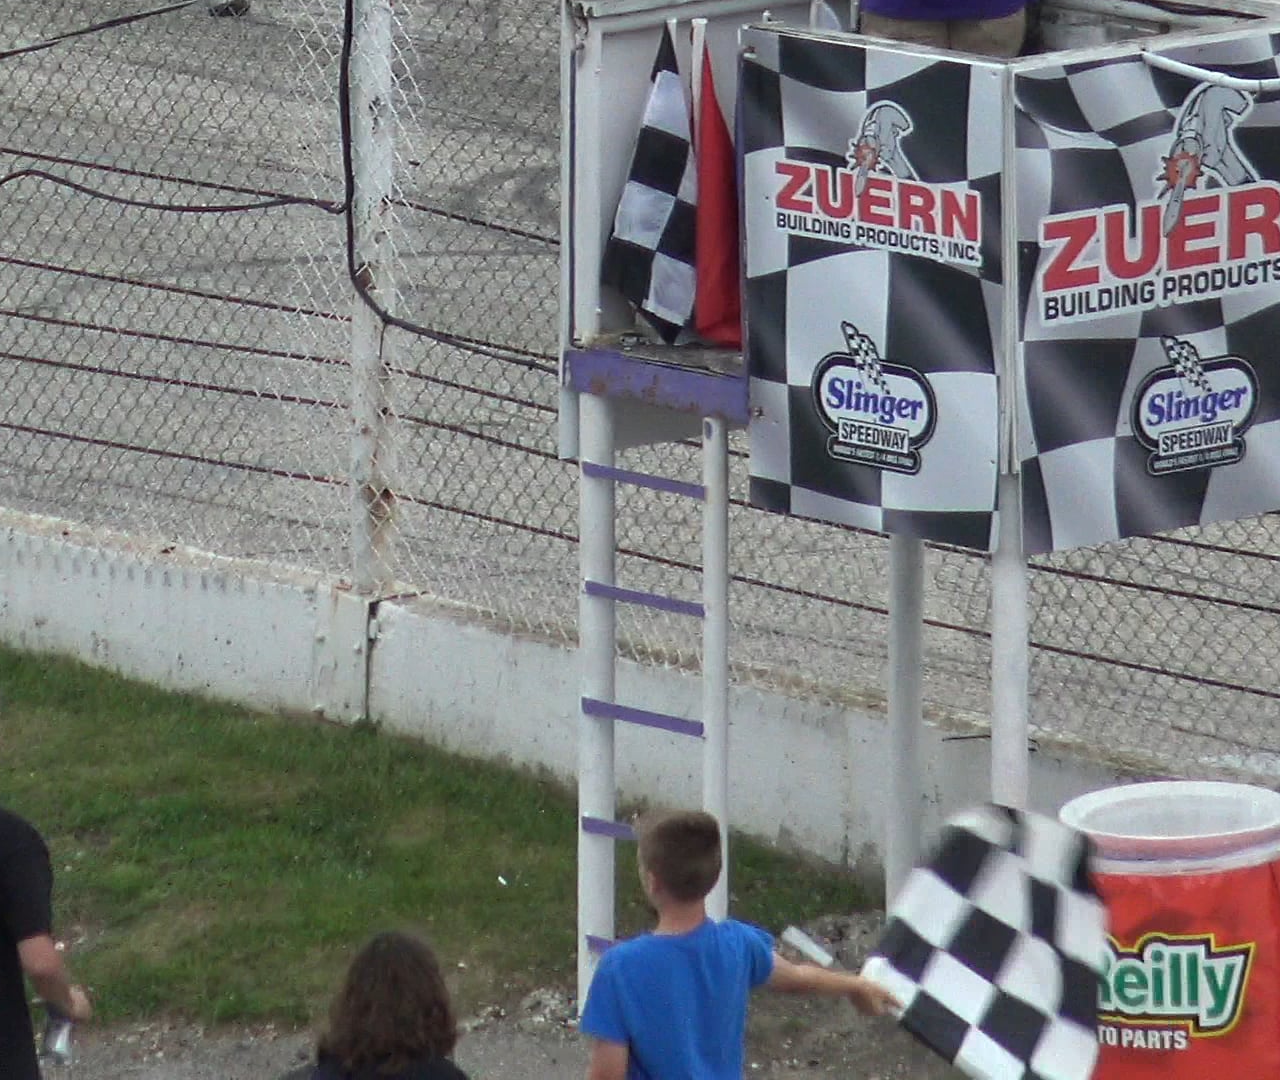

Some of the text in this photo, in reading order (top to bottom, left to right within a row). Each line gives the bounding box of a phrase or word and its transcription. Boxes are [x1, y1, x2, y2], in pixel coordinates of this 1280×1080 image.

[775, 161, 979, 242] ZUERN
[776, 212, 980, 262] BUILDING PRODUCTS, INC.
[1043, 279, 1155, 321] BUILDING
[826, 376, 923, 424] Slinger
[1146, 385, 1248, 426] Slinger
[840, 421, 907, 450] SPEEDWAY
[1161, 423, 1232, 453] SPEEDWAY
[1121, 1027, 1188, 1050] PARTS
